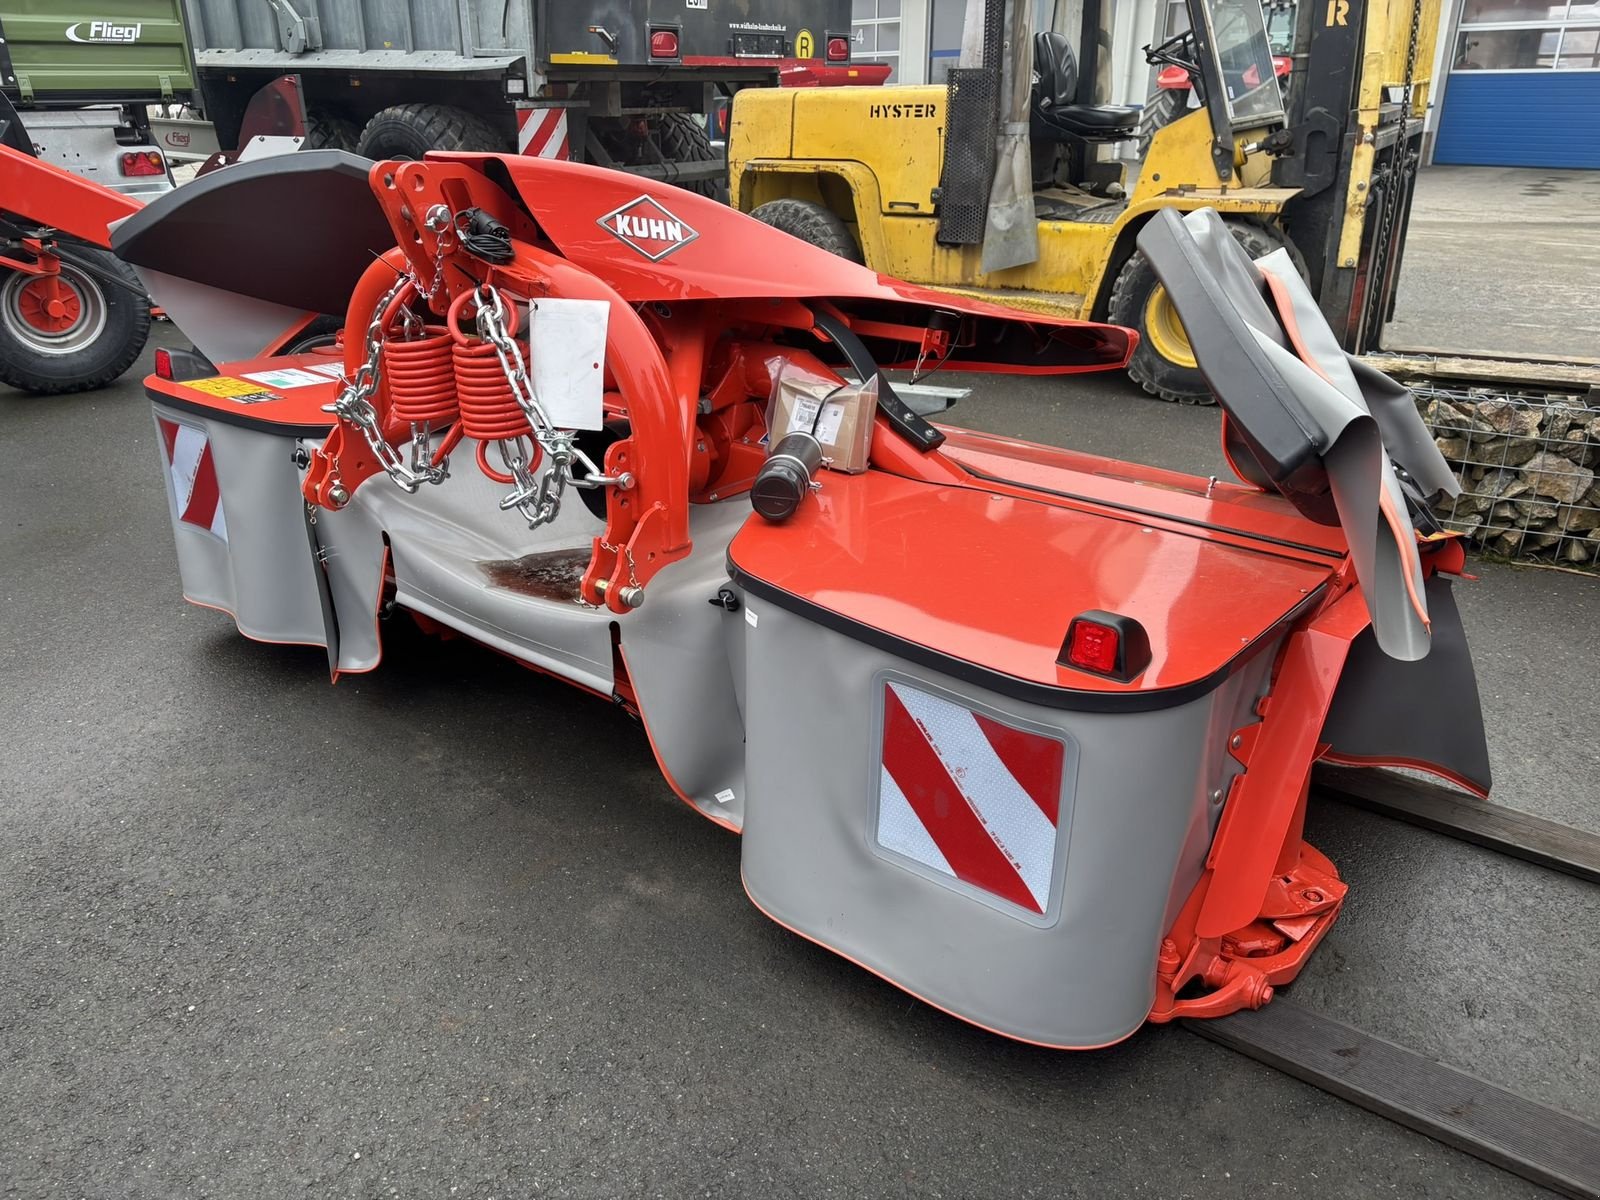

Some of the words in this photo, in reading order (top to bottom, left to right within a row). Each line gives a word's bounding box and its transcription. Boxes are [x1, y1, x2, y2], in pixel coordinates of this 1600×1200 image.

[90, 21, 142, 42] Fliegl
[800, 37, 809, 58] R
[870, 104, 936, 118] HYSTER
[616, 213, 683, 242] KUHN
